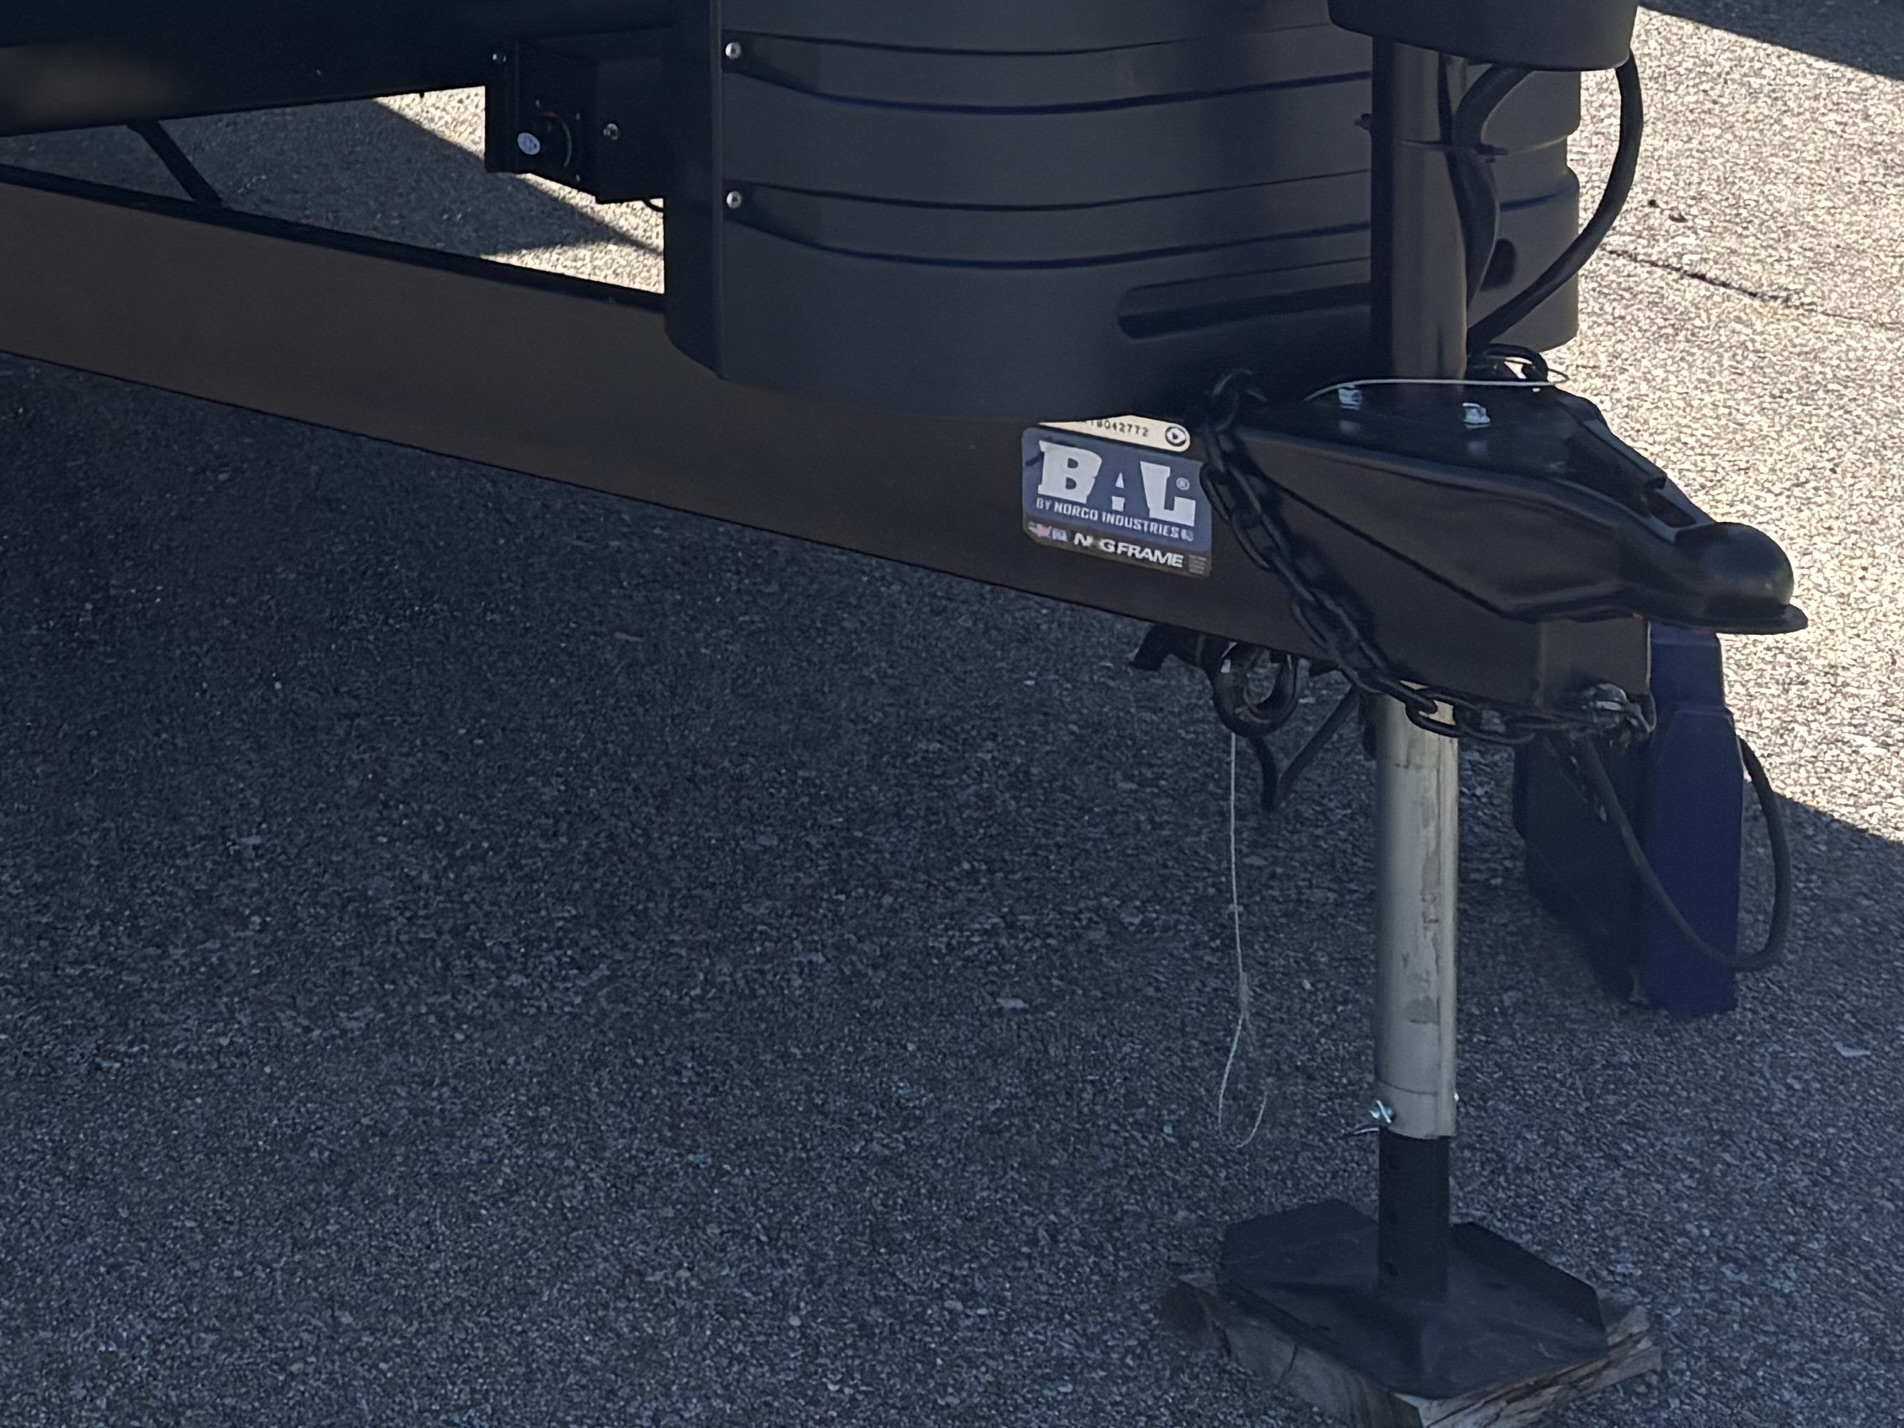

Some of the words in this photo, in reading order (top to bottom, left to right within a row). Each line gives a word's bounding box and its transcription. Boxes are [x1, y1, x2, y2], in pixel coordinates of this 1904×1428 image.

[1037, 440, 1196, 527] BAL
[1036, 497, 1052, 512] BY
[1054, 501, 1099, 521] NORCO
[1102, 511, 1180, 539] INDUSTRIES
